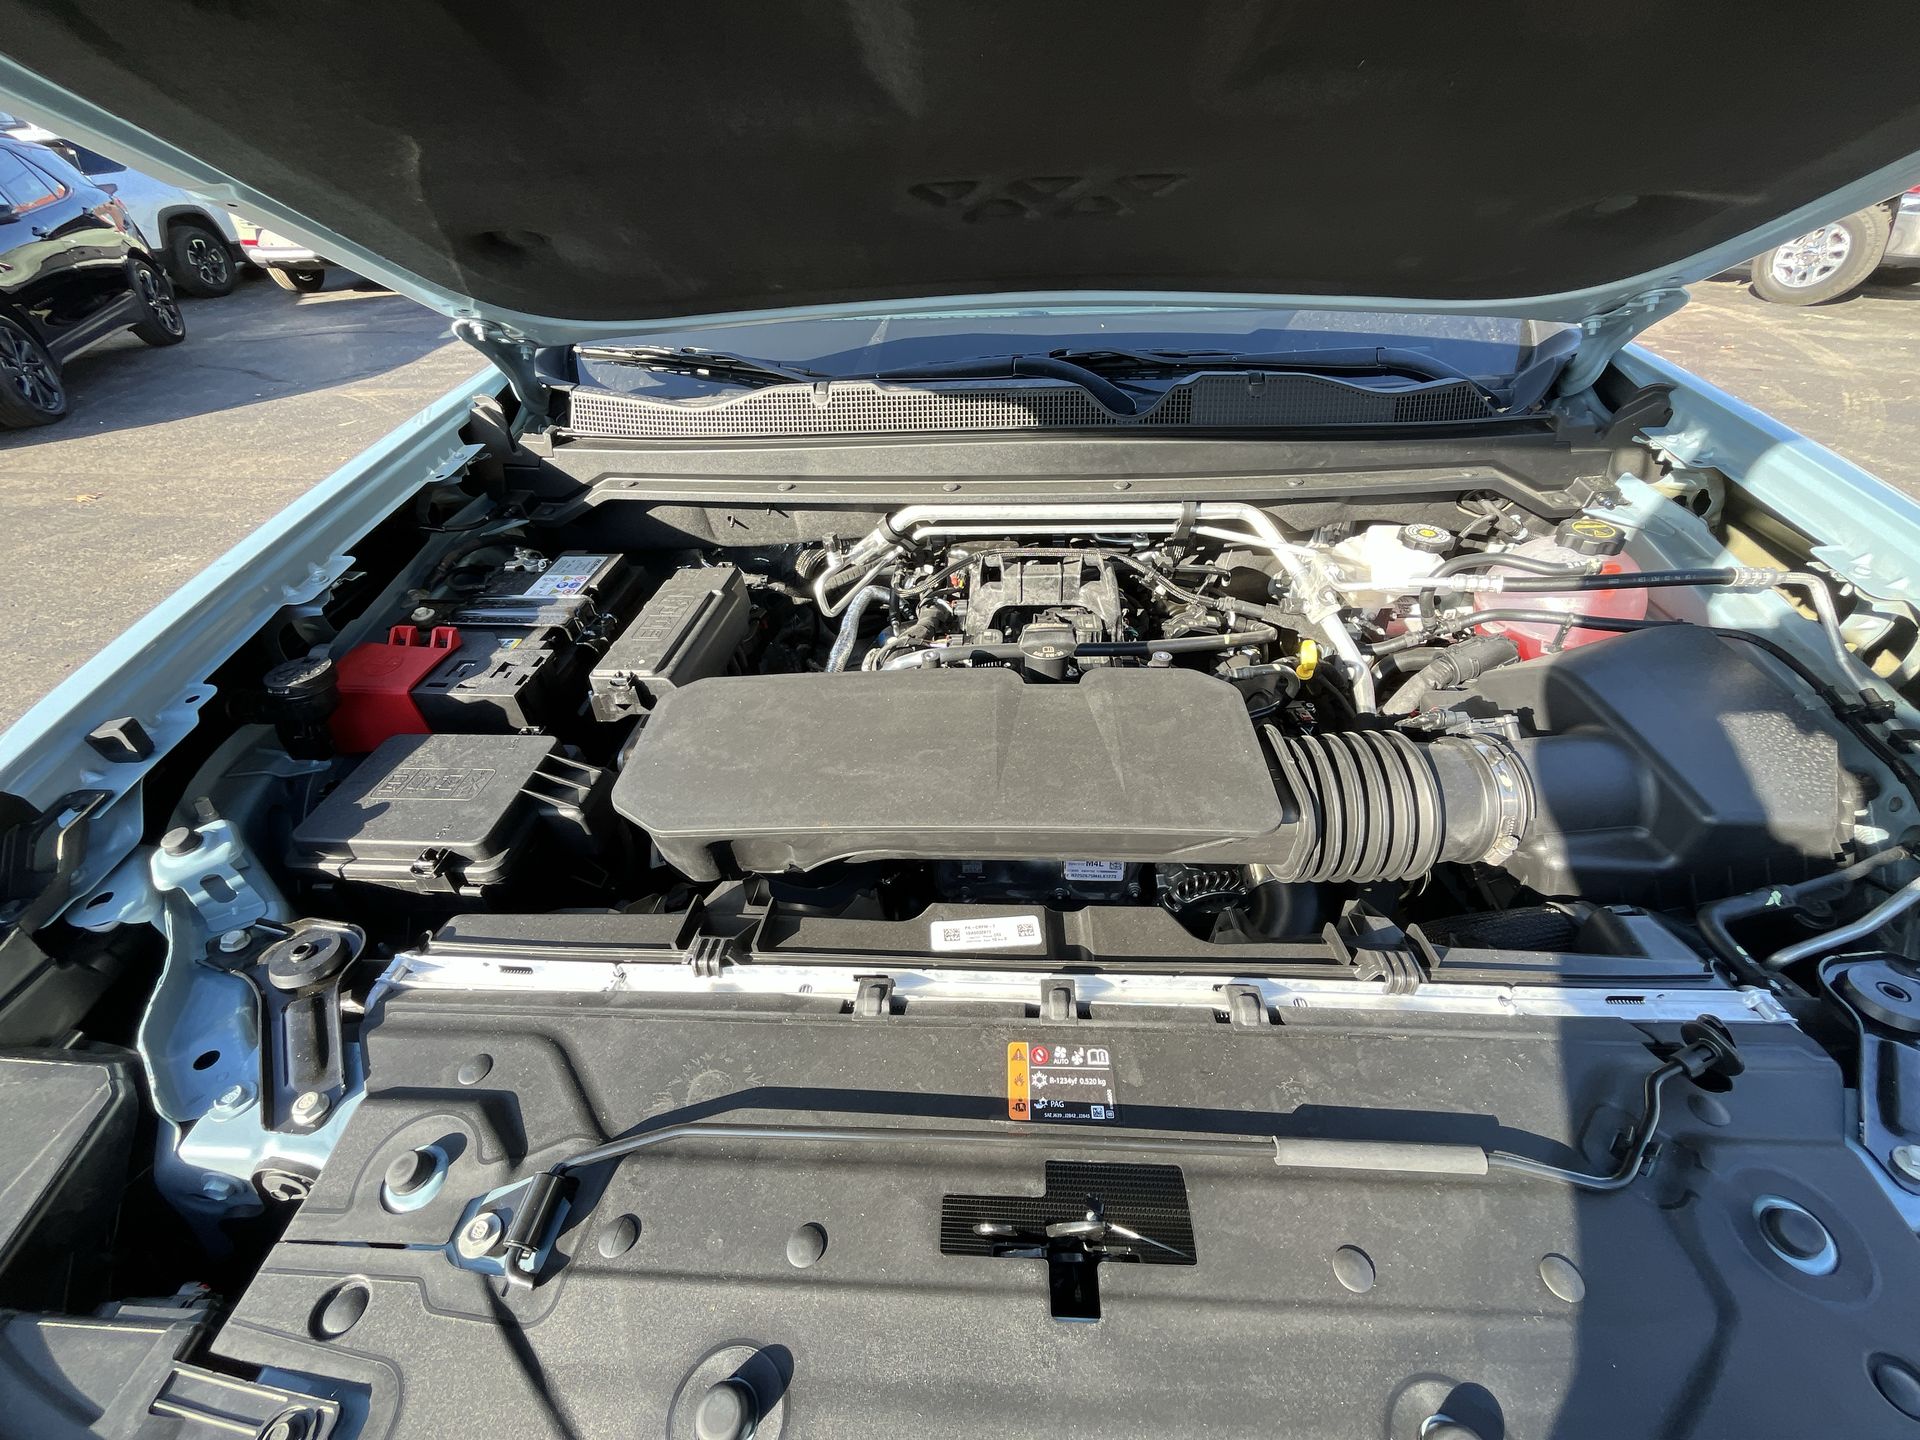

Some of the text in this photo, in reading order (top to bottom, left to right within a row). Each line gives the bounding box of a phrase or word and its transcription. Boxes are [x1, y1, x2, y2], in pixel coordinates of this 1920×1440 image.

[1049, 1077, 1107, 1087] R-1234yf 0.520 kg
[1050, 1100, 1065, 1108] PAG
